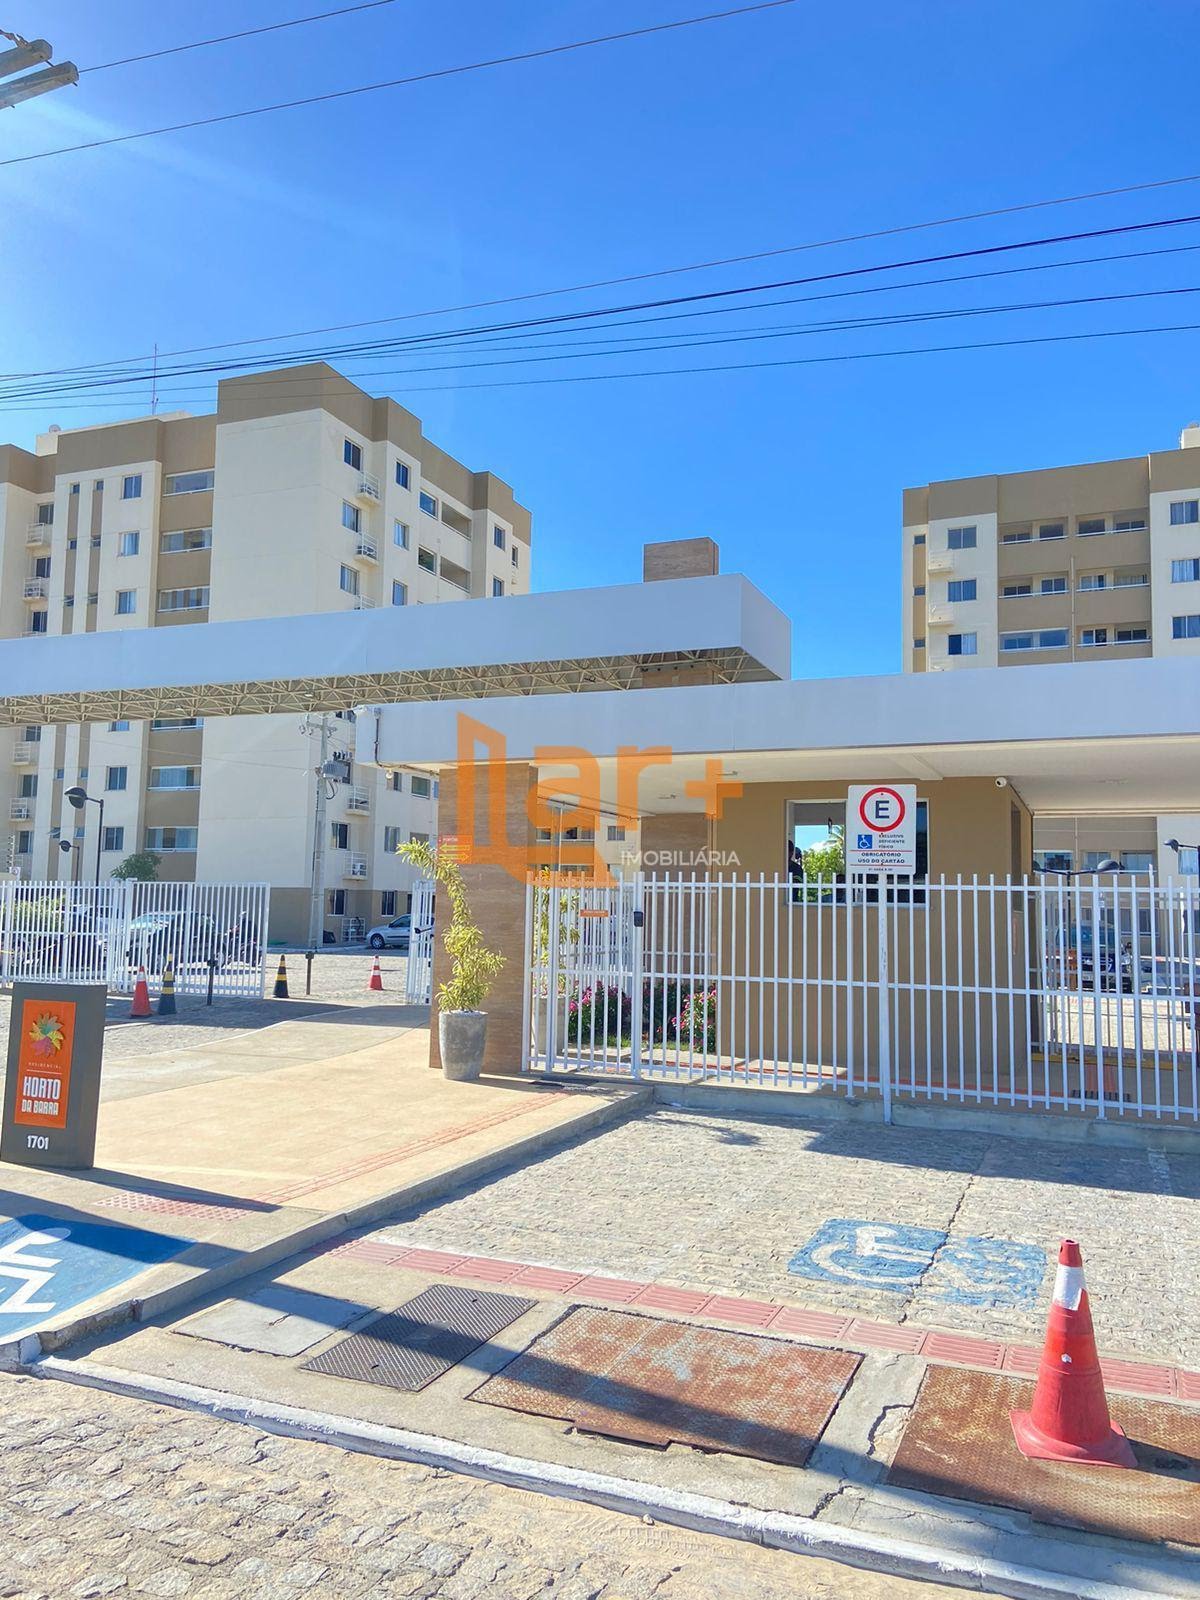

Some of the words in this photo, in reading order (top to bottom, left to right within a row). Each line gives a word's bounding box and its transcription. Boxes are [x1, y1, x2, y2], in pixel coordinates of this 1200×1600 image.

[875, 800, 890, 819] E
[23, 1076, 61, 1100] HORTO
[22, 1099, 32, 1112] DA
[33, 1100, 59, 1115] BARRA
[27, 1135, 49, 1149] 1701
